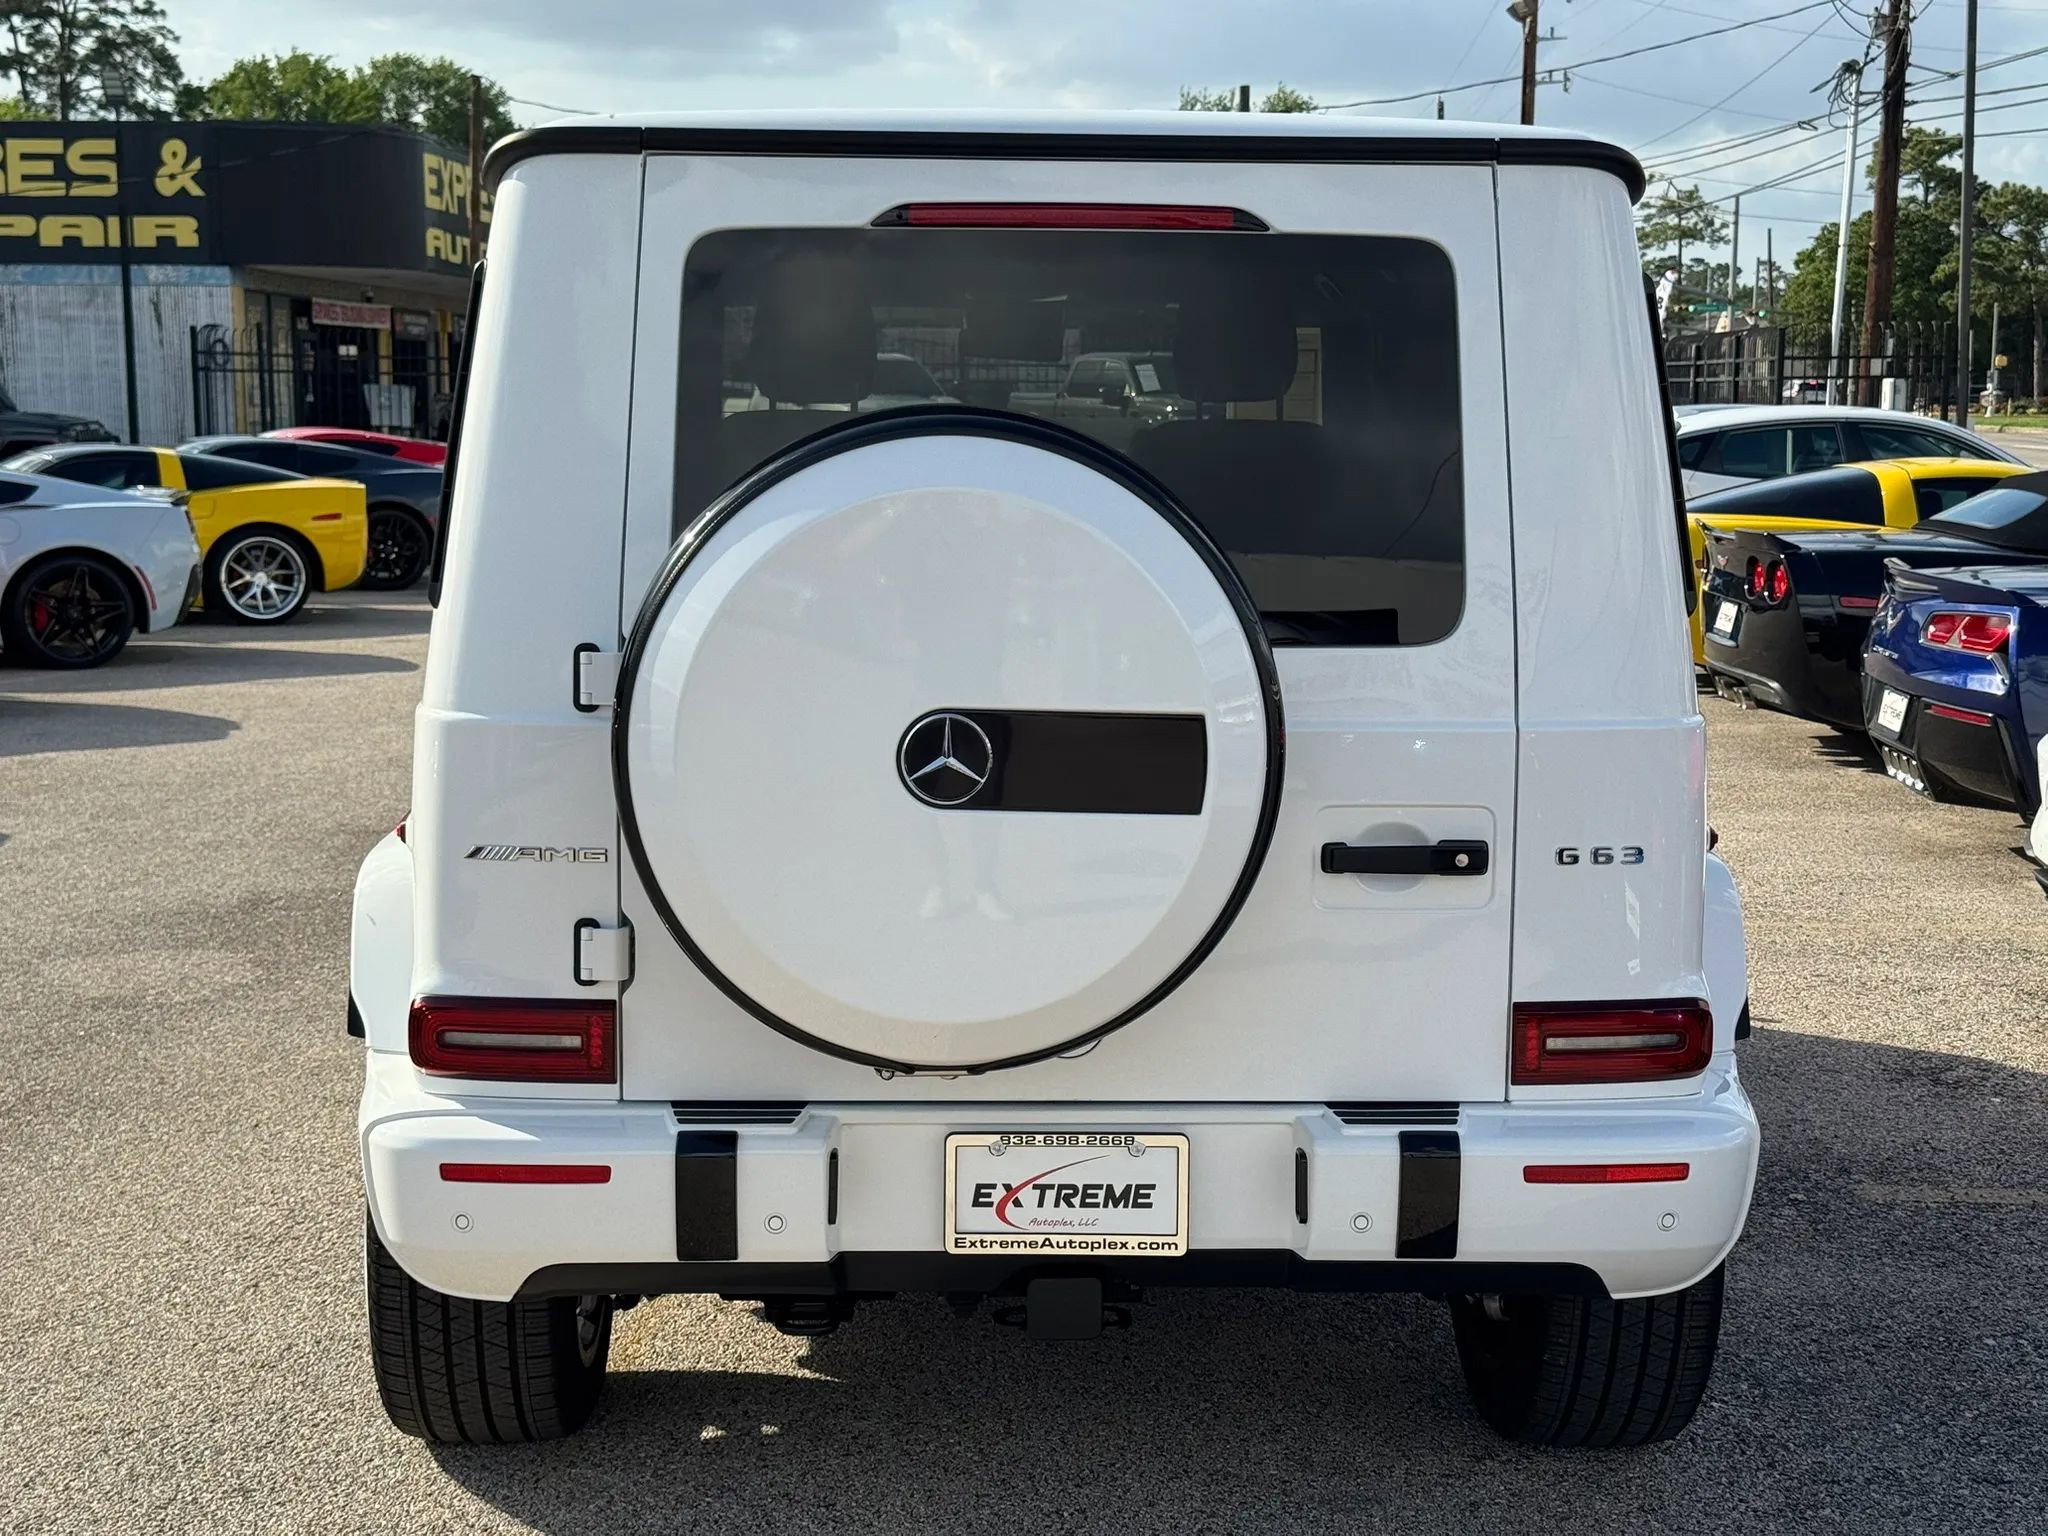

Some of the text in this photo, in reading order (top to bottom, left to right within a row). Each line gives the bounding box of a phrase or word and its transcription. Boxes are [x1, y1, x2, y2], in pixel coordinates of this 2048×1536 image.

[0, 138, 206, 197] ES &
[425, 227, 487, 266] AUT
[1555, 846, 1645, 866] G 63
[999, 1135, 1135, 1146] 832-698-2668
[971, 1182, 1157, 1209] EXTREME
[1028, 1217, 1099, 1228] Autoplex, LLC
[954, 1237, 1178, 1251] ExtremeAutoplex.com
